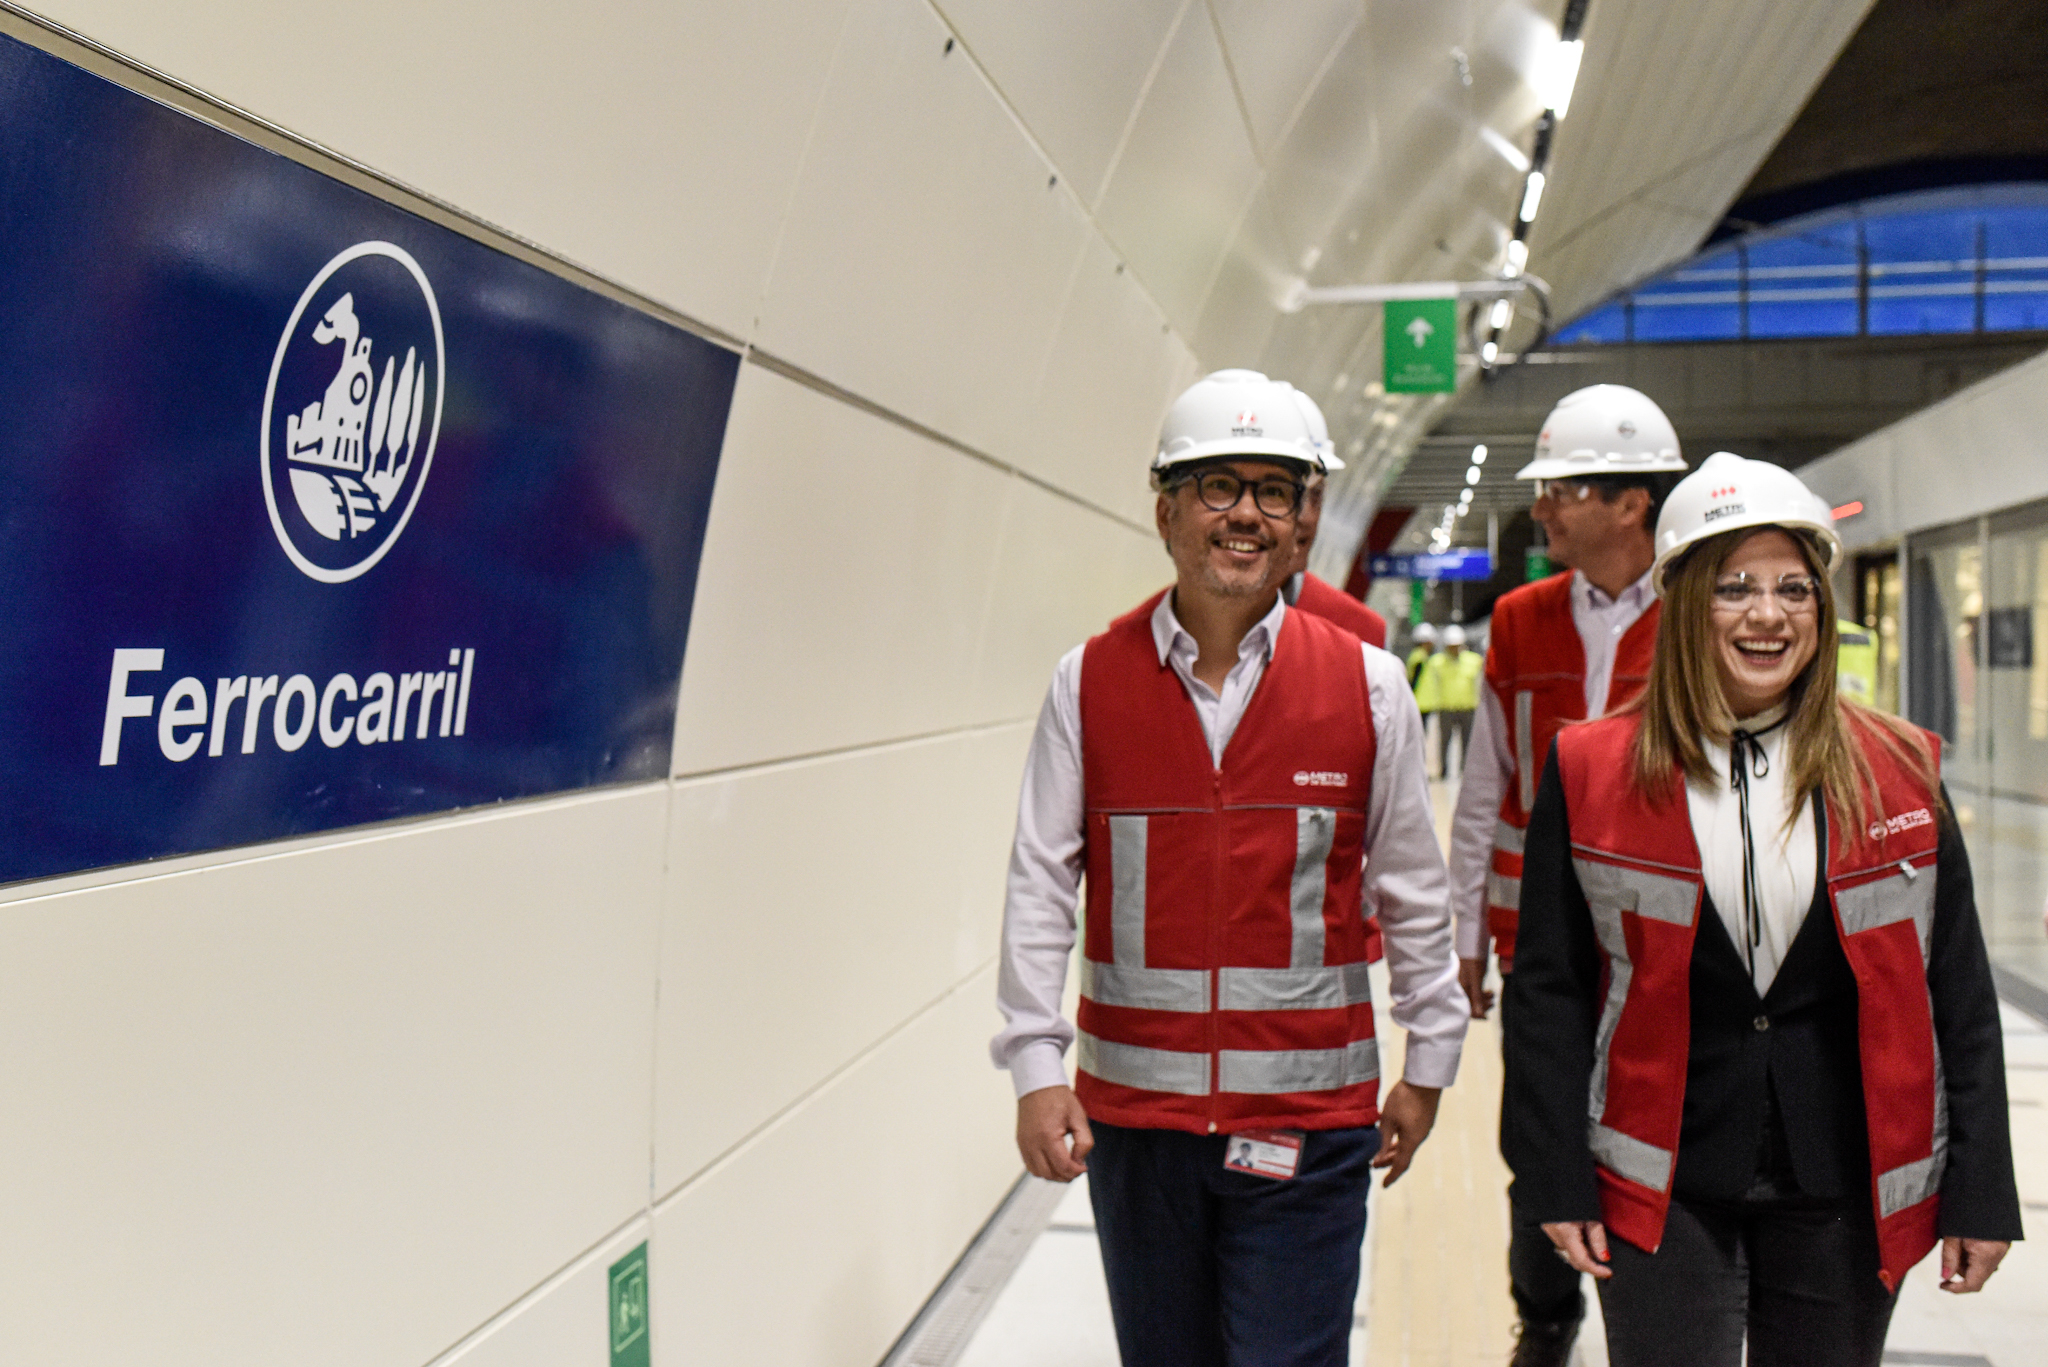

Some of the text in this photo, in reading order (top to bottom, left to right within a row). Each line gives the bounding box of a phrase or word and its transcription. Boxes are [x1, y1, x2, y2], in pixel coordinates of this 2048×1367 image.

[99, 648, 475, 766] Ferrocarril
[1310, 771, 1348, 783] METRO
[1886, 808, 1930, 828] METRO
